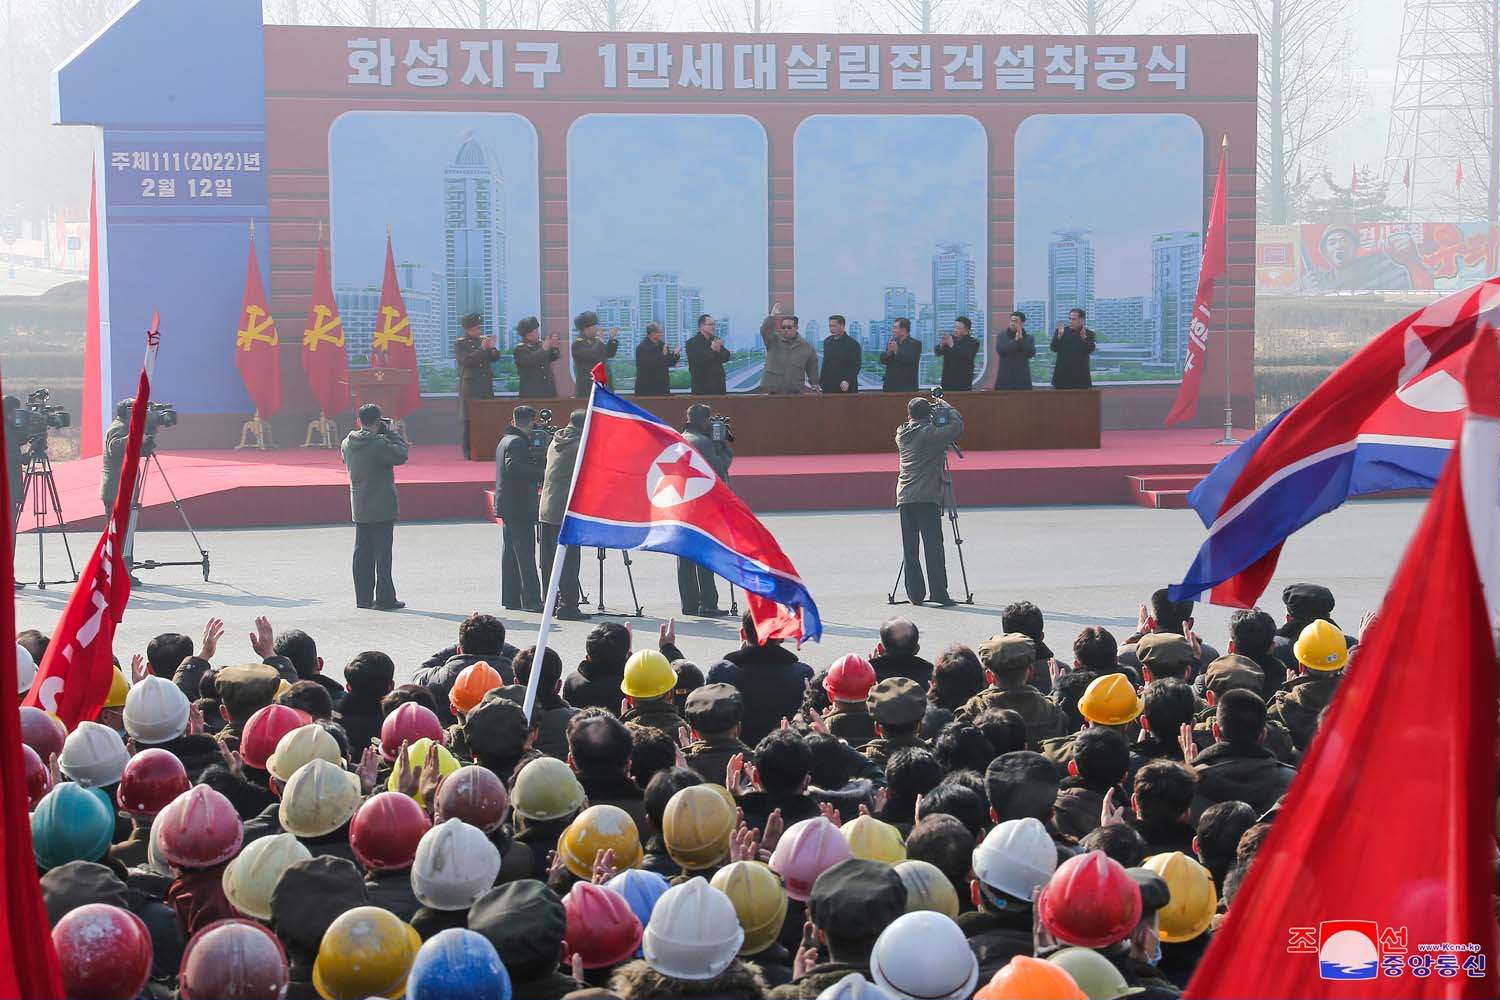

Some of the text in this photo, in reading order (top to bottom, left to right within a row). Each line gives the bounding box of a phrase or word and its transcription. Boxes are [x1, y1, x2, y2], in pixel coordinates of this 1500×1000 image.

[346, 37, 1187, 91] 화성지구 1만세대살림집건설착공식
[111, 152, 260, 171] 주체111(2022)년
[142, 178, 233, 198] 2월 12일
